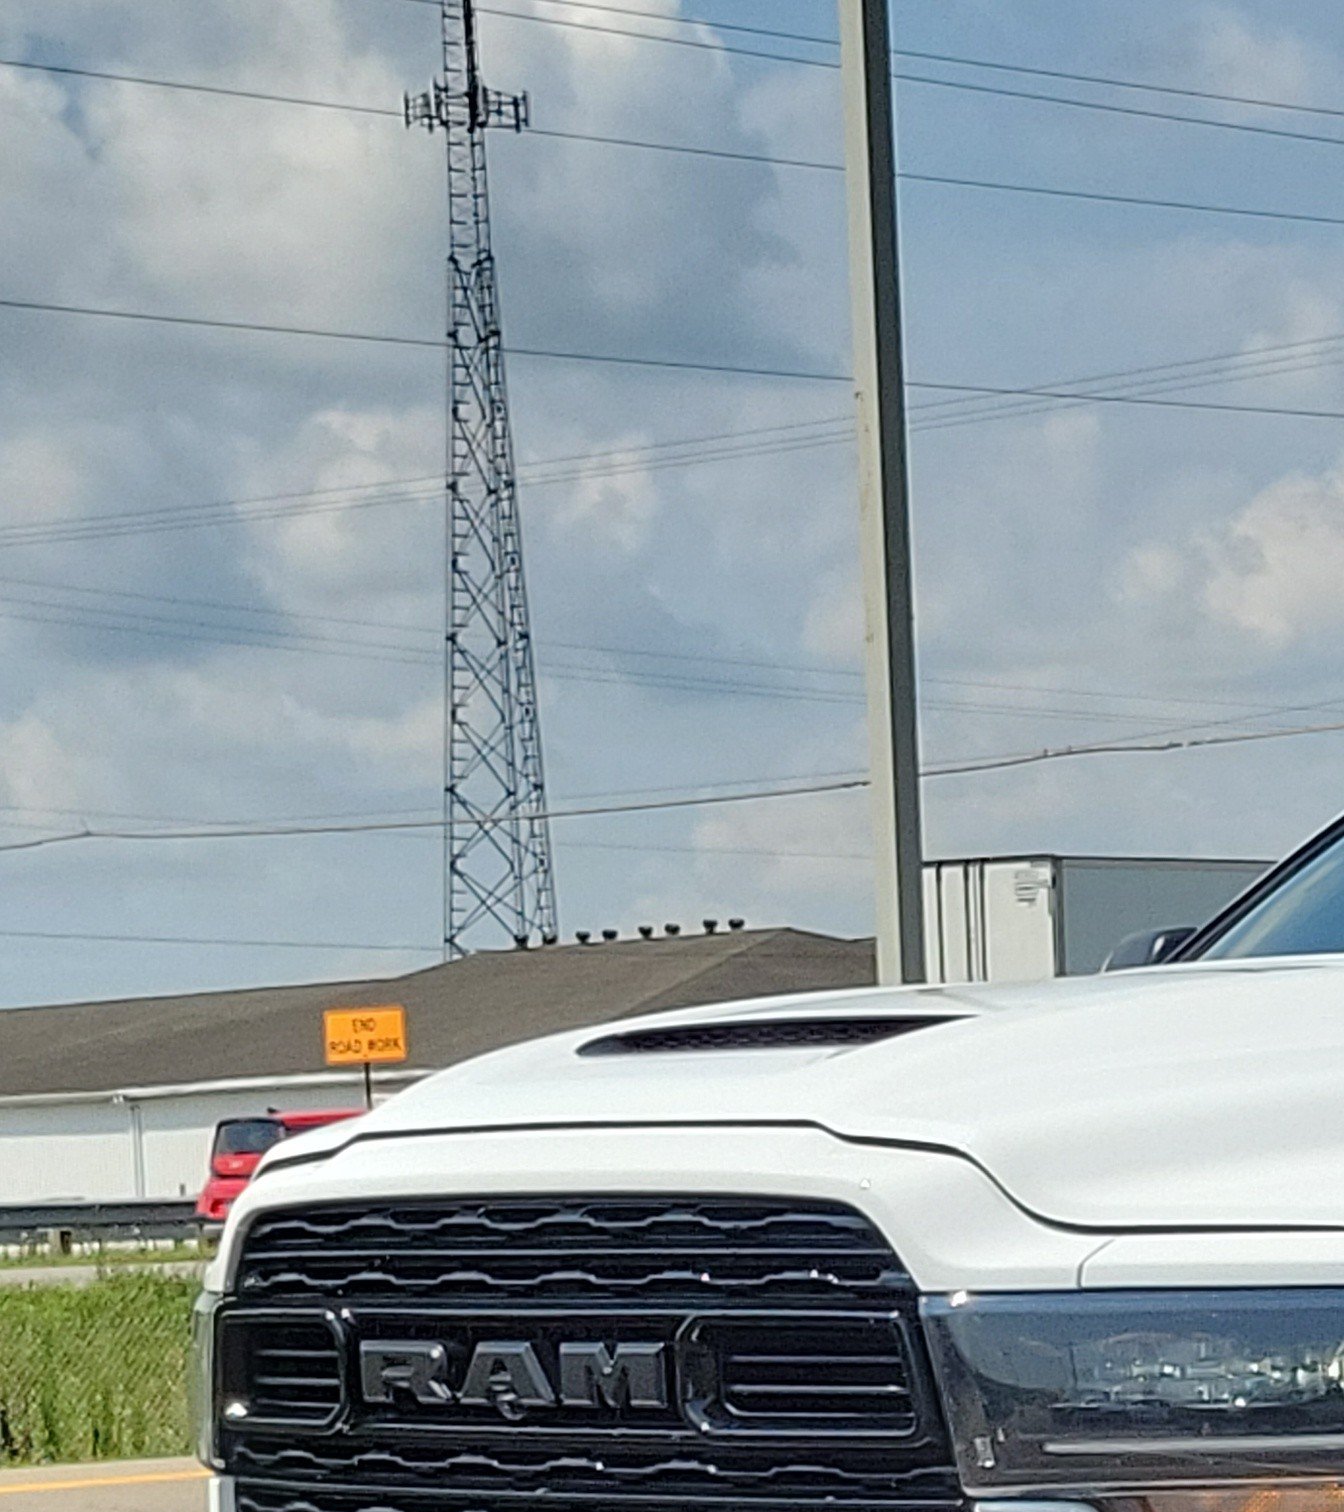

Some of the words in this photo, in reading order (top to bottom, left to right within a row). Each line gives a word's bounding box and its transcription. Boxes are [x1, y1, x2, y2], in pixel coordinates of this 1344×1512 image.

[351, 1017, 376, 1034] END
[329, 1039, 362, 1055] ROAD
[367, 1037, 402, 1052] WORK
[359, 1339, 668, 1408] RAM
